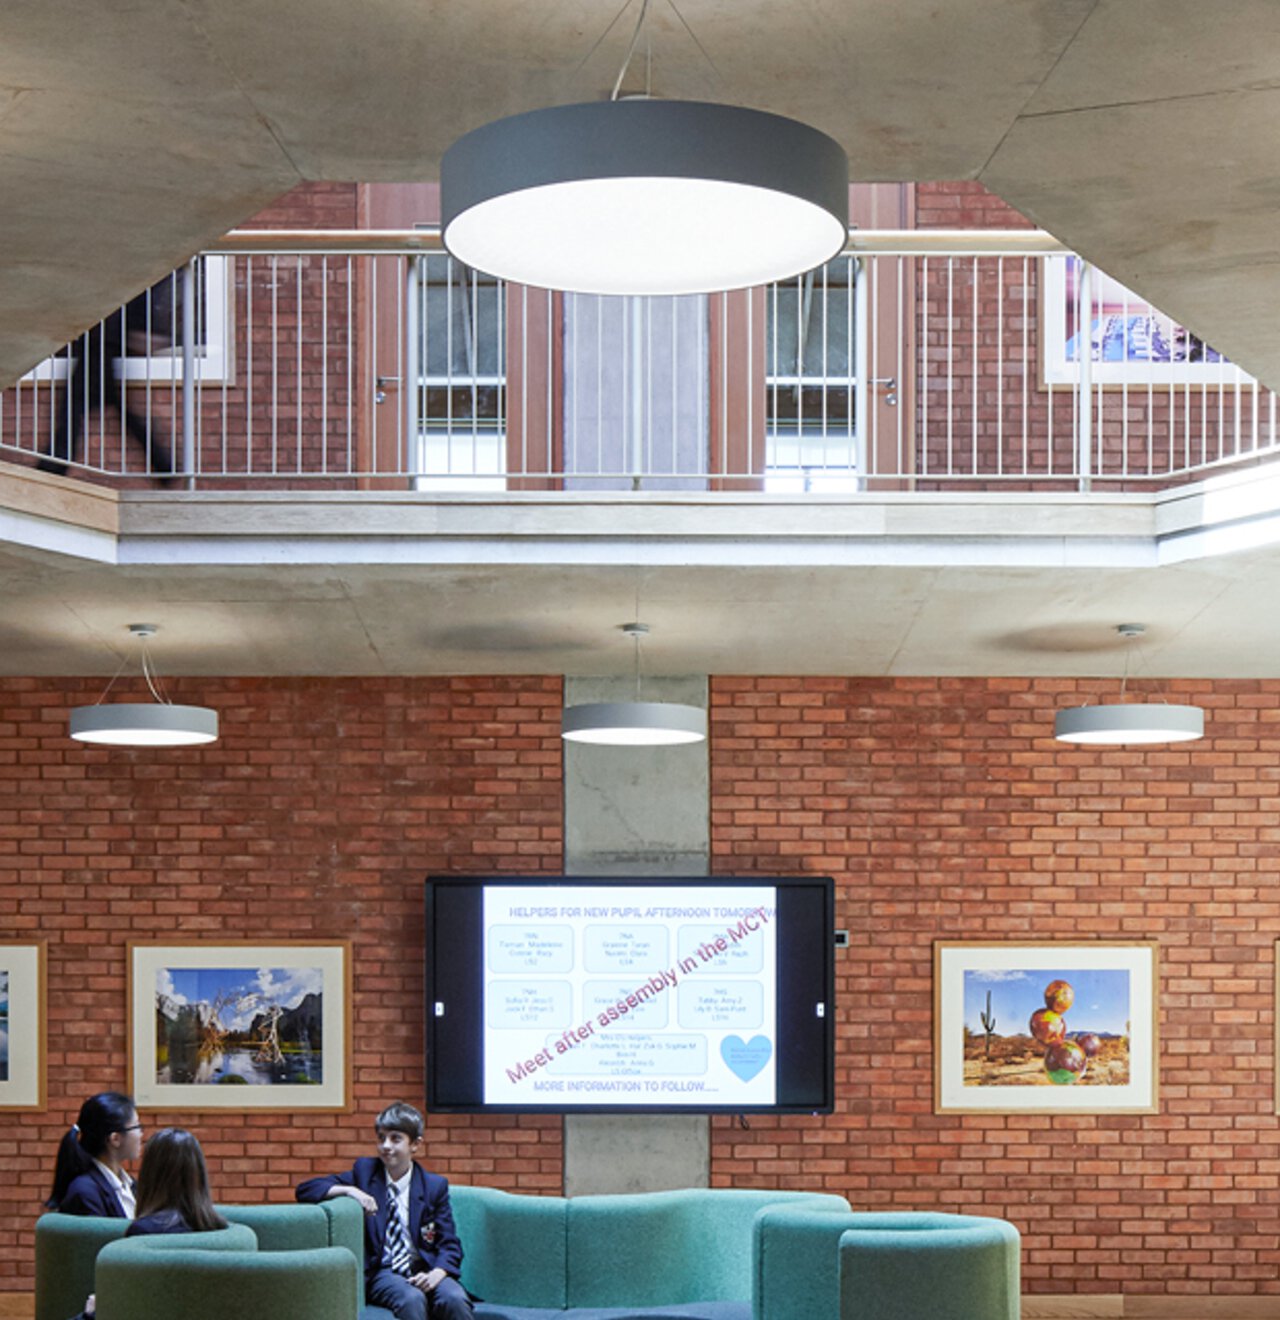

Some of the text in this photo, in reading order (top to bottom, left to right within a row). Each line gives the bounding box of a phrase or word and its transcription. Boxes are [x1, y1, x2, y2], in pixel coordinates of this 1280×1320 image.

[509, 906, 777, 918] HELPERS FOR NEW PUPIL AFTERNOON TOMORW
[505, 905, 769, 1085] Meet after assembly in the MCT
[534, 1080, 564, 1092] MORE
[568, 1080, 640, 1092] INFORMATION
[645, 1080, 659, 1092] TO
